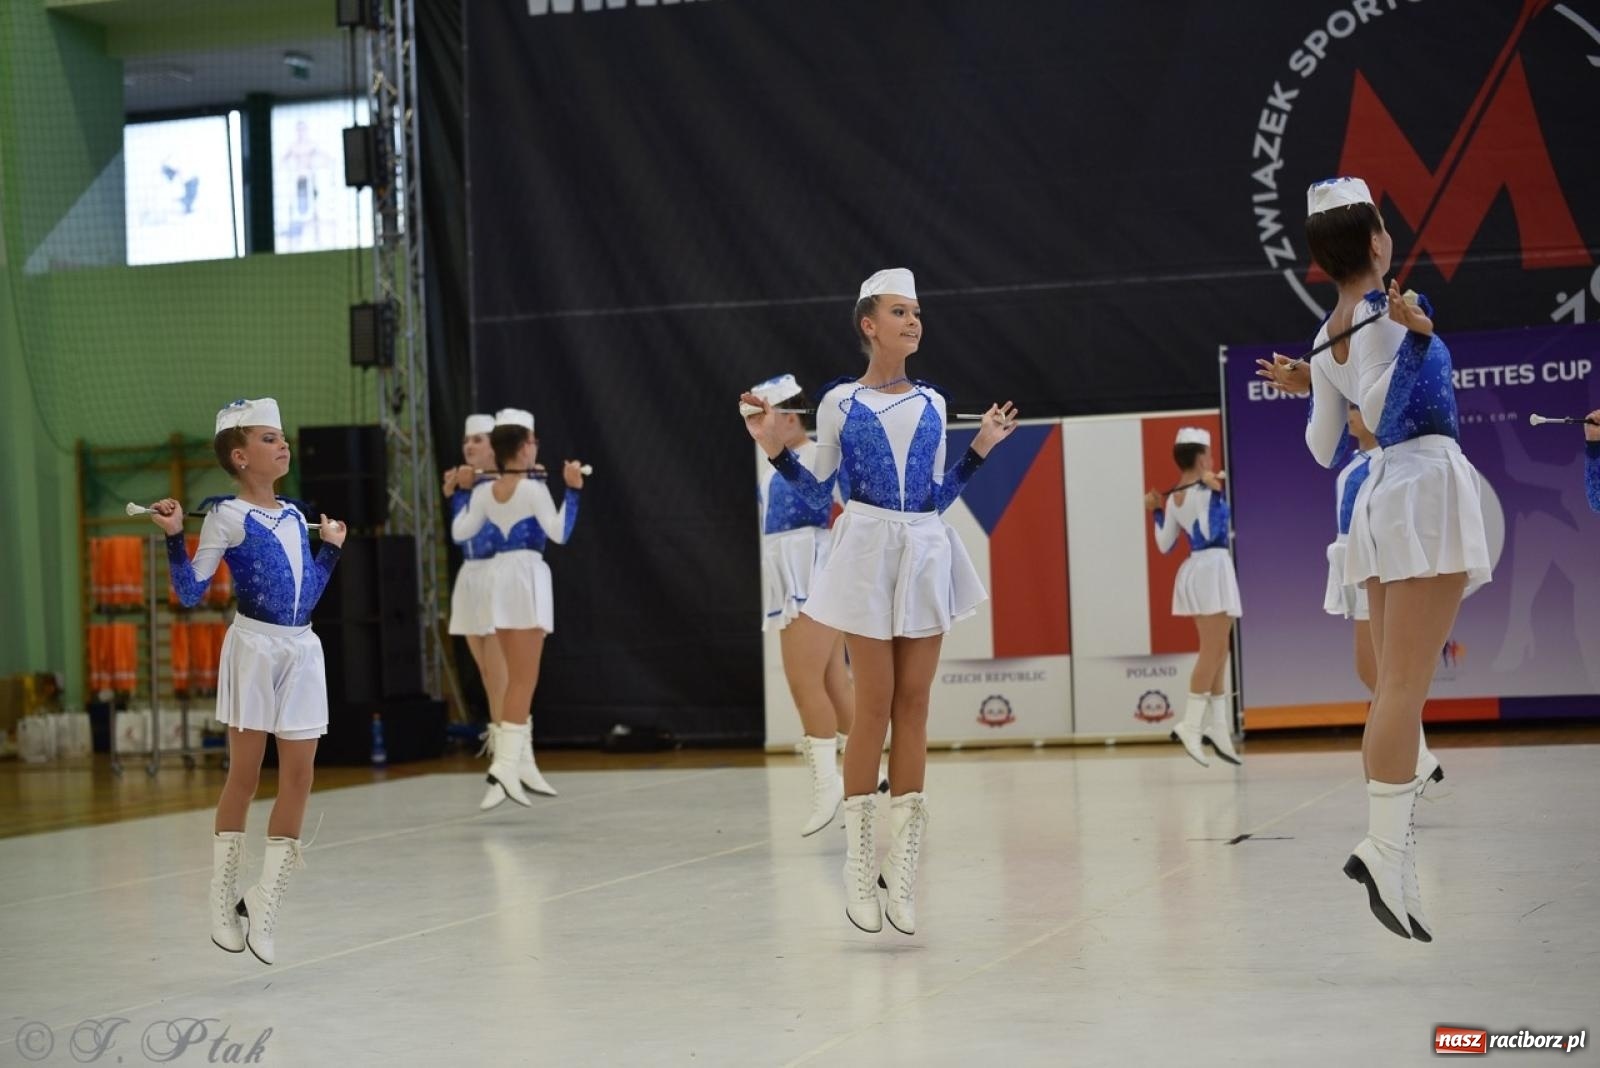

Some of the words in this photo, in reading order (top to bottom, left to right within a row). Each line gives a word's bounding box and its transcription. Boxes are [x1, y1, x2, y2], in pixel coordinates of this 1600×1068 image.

[1252, 81, 1299, 268] ZWIĄZEK
[1289, 0, 1421, 78] SPOR
[1542, 359, 1592, 382] CUP
[941, 672, 982, 684] CZECH
[985, 670, 1046, 683] REPUBLIC
[1126, 666, 1178, 679] POLAND
